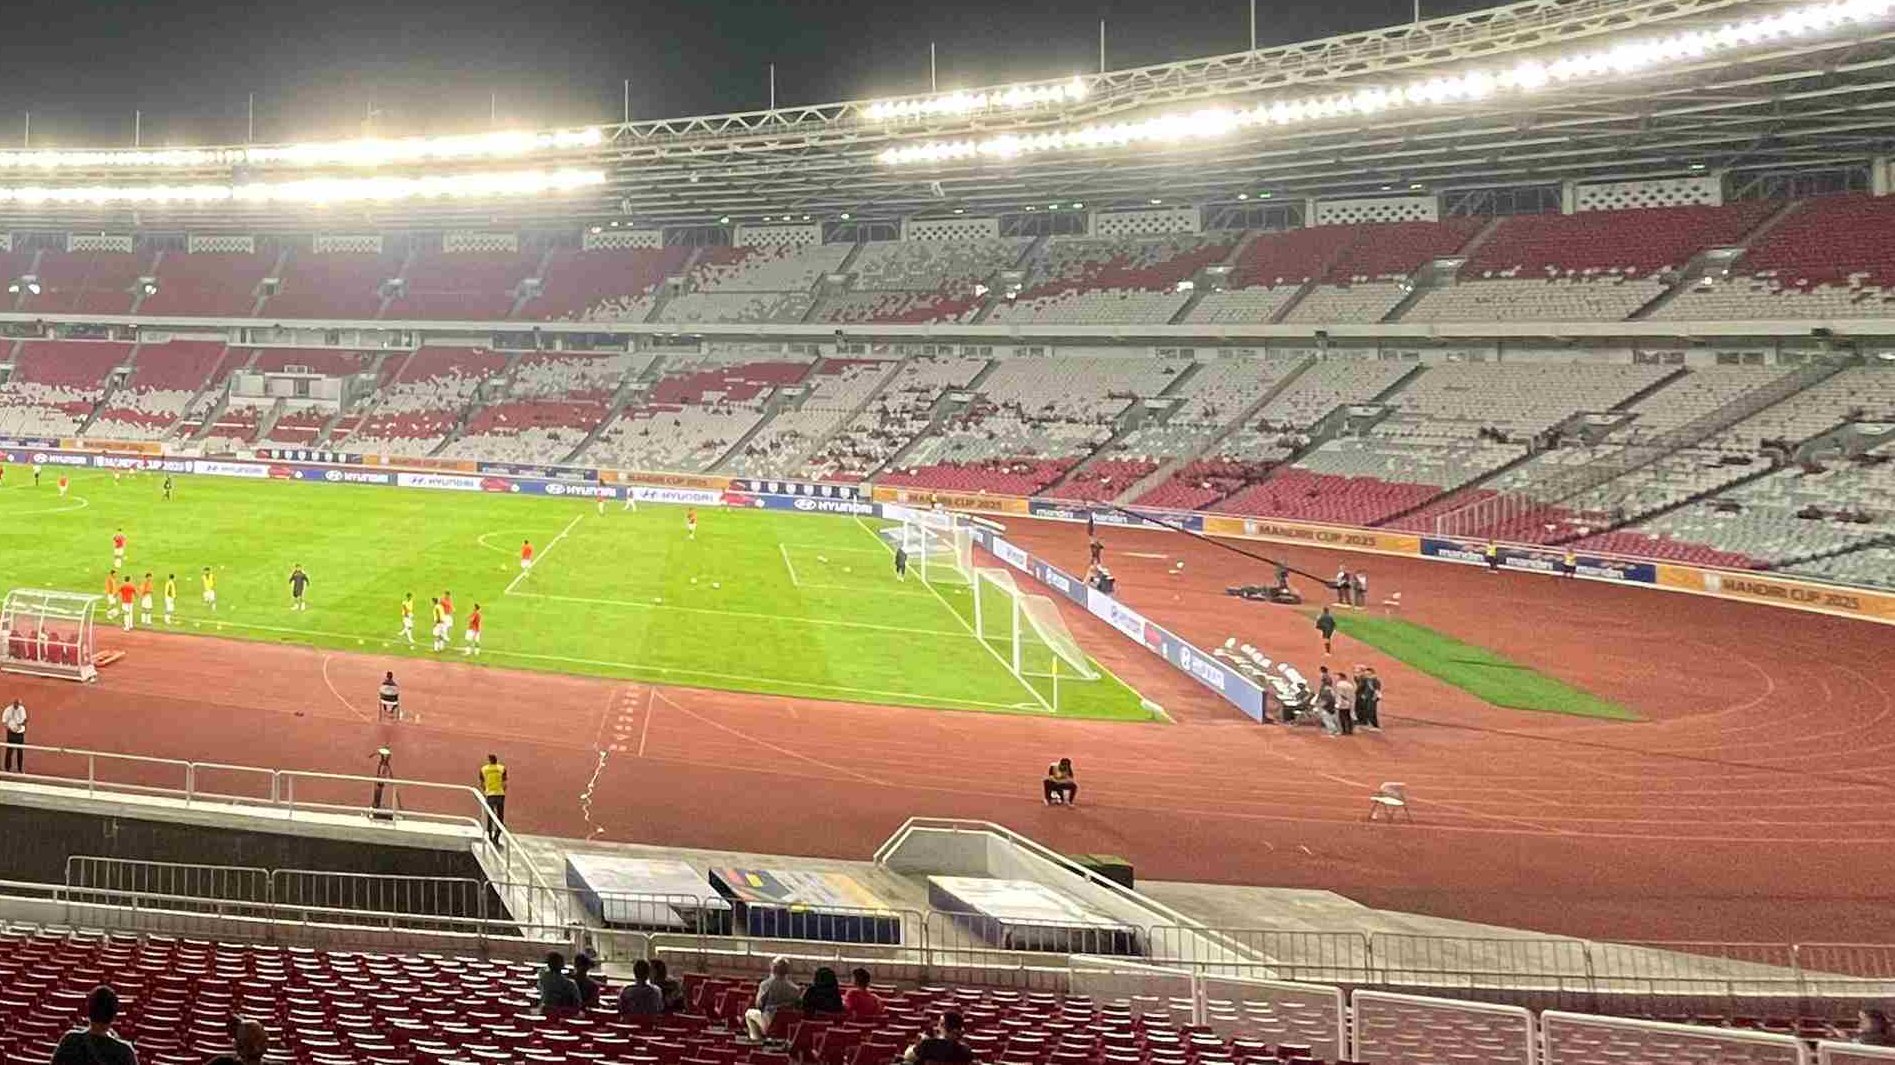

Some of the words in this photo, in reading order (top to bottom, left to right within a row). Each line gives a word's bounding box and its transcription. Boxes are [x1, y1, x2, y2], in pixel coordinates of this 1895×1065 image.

[818, 501, 873, 515] HYUNDAI
[1316, 531, 1343, 543] CUP
[1345, 533, 1376, 546] 2025
[1722, 578, 1787, 600] MANDIRI
[1790, 588, 1820, 603] CUP
